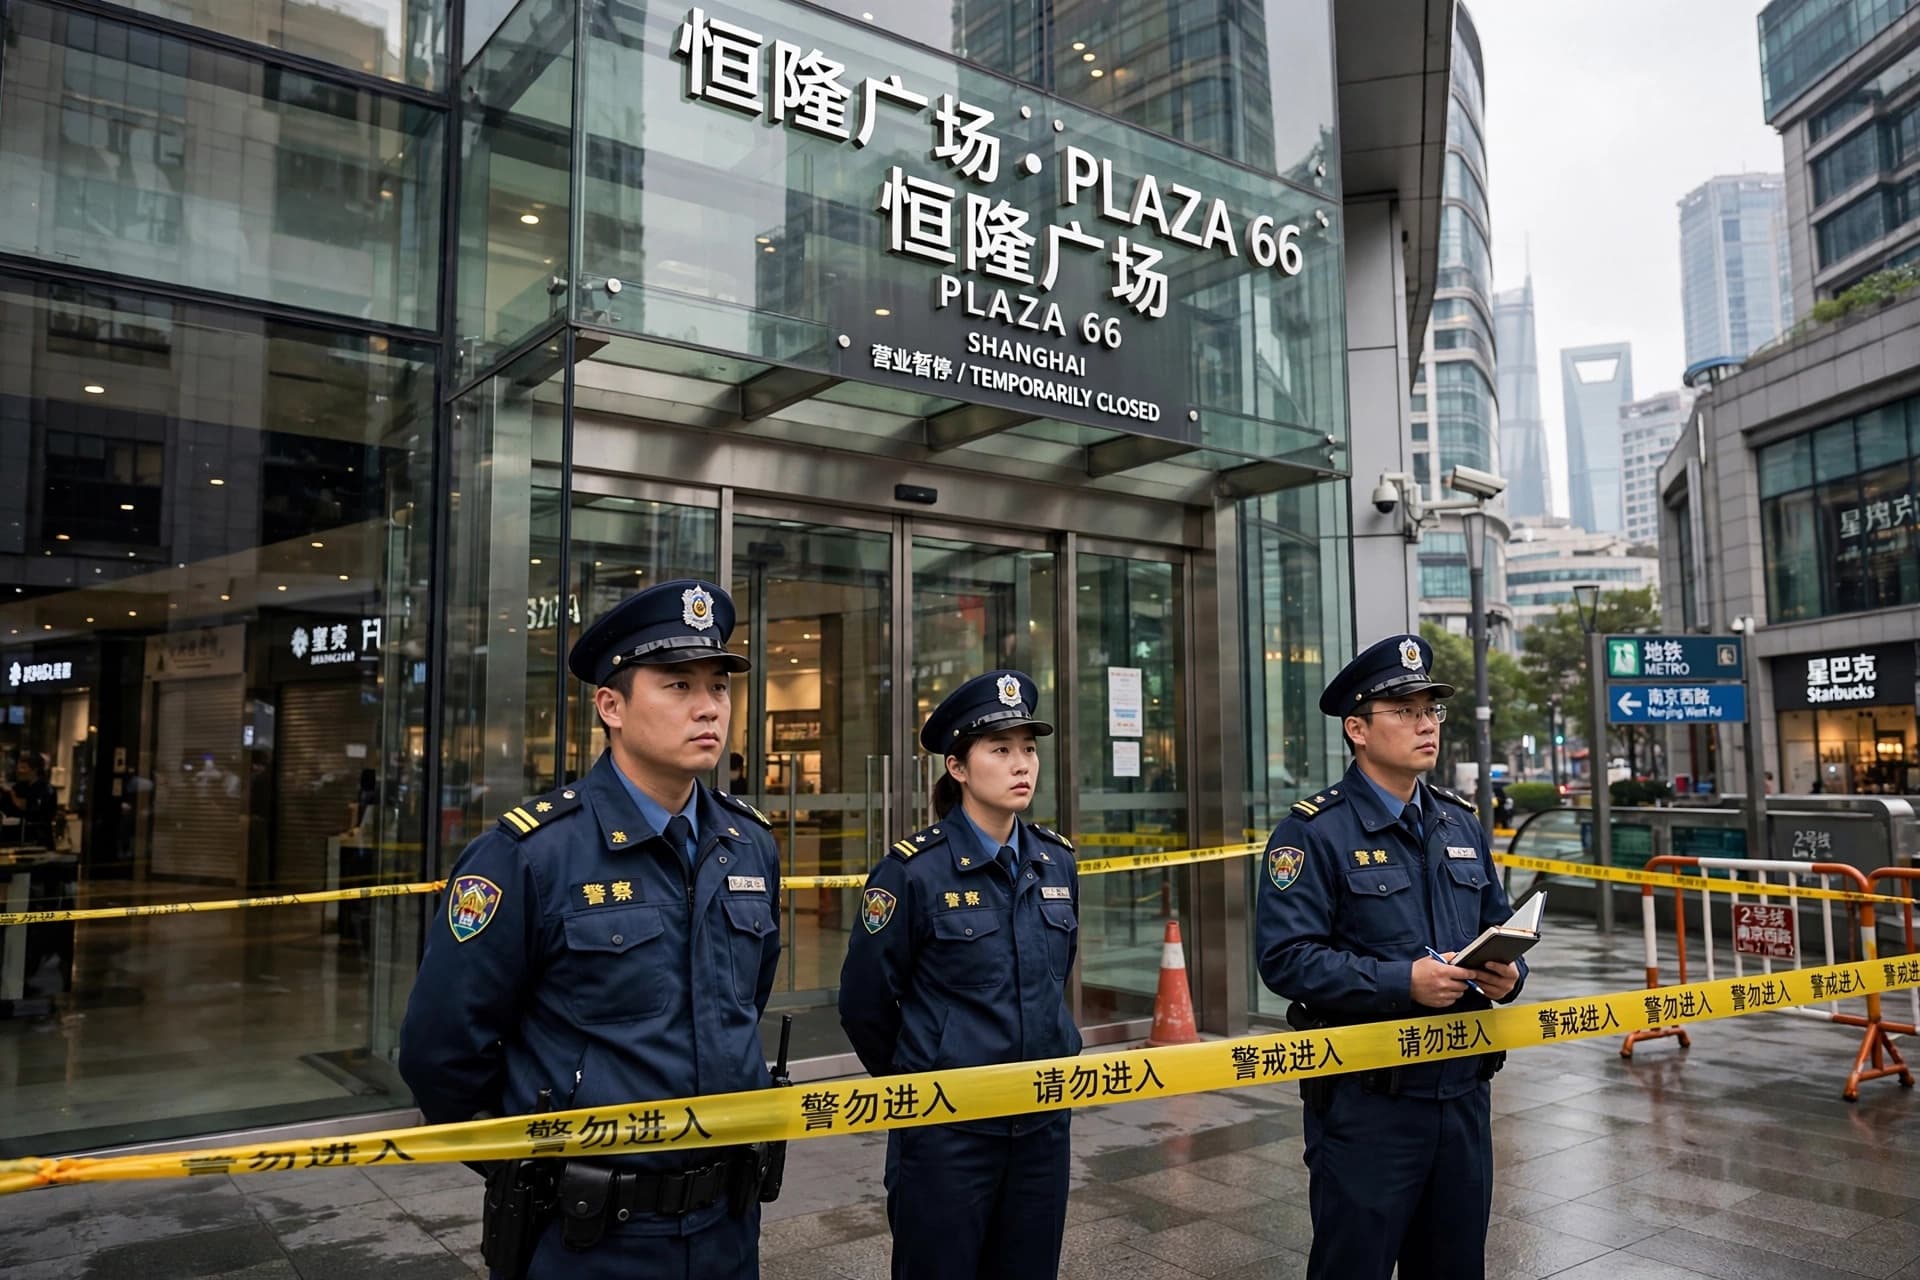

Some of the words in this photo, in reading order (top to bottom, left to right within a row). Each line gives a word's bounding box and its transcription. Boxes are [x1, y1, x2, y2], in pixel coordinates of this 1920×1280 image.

[677, 7, 1000, 183] 恒隆广场
[1061, 145, 1238, 257] PLAZA
[1245, 215, 1303, 277] 66
[878, 166, 1169, 319] 恒隆广场
[937, 274, 1067, 337] PLAZA
[1079, 312, 1122, 349] 66
[967, 332, 1086, 377] SHANGHAI
[871, 343, 953, 381] 营业暂停
[969, 364, 1093, 408] TEMPORARILY
[1096, 392, 1160, 422] CLOSED
[1644, 640, 1683, 662] 地铁
[1645, 662, 1690, 675] METRO
[1807, 653, 1877, 686] 星巴克
[1648, 688, 1710, 705] 南京西路
[1807, 683, 1875, 703] Starbucks
[583, 880, 633, 905] 警察
[1644, 991, 1712, 1025] 警勿进入
[1731, 980, 1791, 1011] 警勿进入
[1231, 1037, 1343, 1081] 警戒进入
[1398, 1019, 1491, 1058] 请勿进入
[1033, 1058, 1164, 1104] 请勿进入
[801, 1081, 957, 1132] 警勿进入
[525, 1106, 713, 1154] 警勿进入
